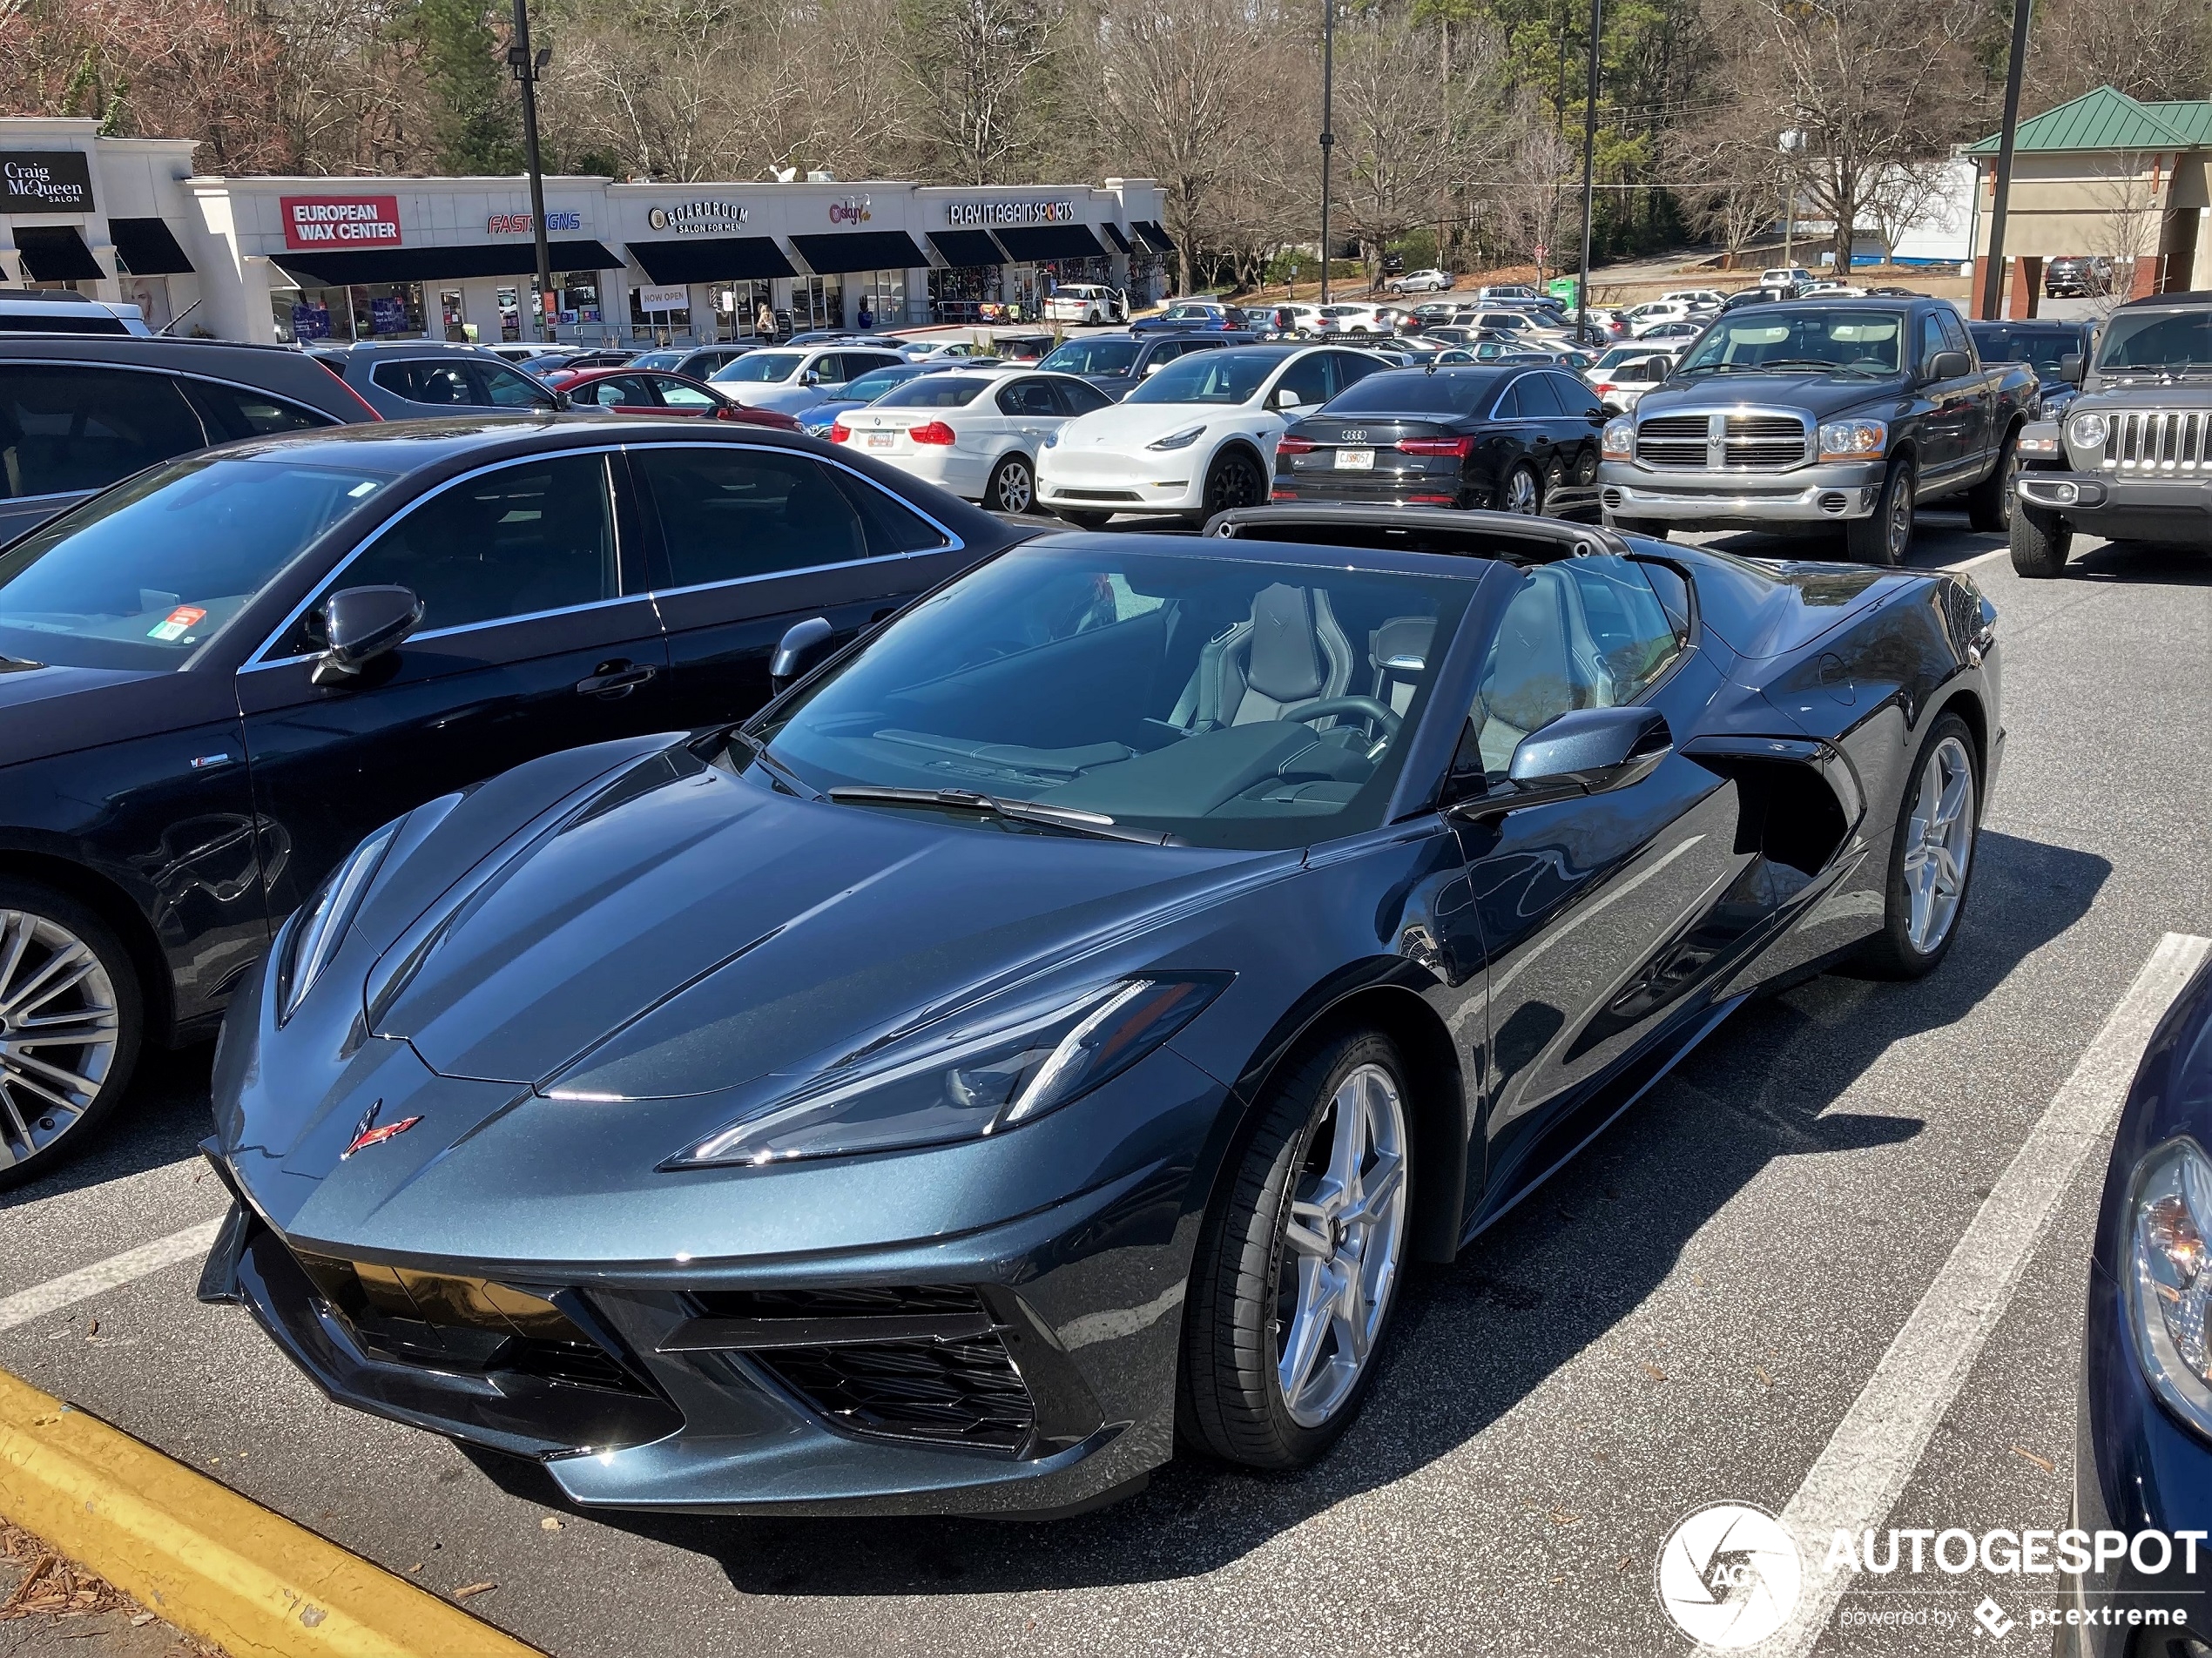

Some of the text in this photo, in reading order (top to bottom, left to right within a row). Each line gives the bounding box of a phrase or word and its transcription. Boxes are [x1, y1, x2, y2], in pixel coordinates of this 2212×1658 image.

[4, 162, 51, 182] Craig
[7, 179, 84, 198] McQueen
[293, 204, 379, 222] EUROPEAN
[665, 201, 749, 226] BOARDROOM
[950, 200, 1074, 225] PLAY IT AGAIN SPORTS
[295, 222, 397, 240] WAX CENTER
[678, 223, 741, 233] SALON FOR MEN
[644, 292, 684, 303] NOW OPEN
